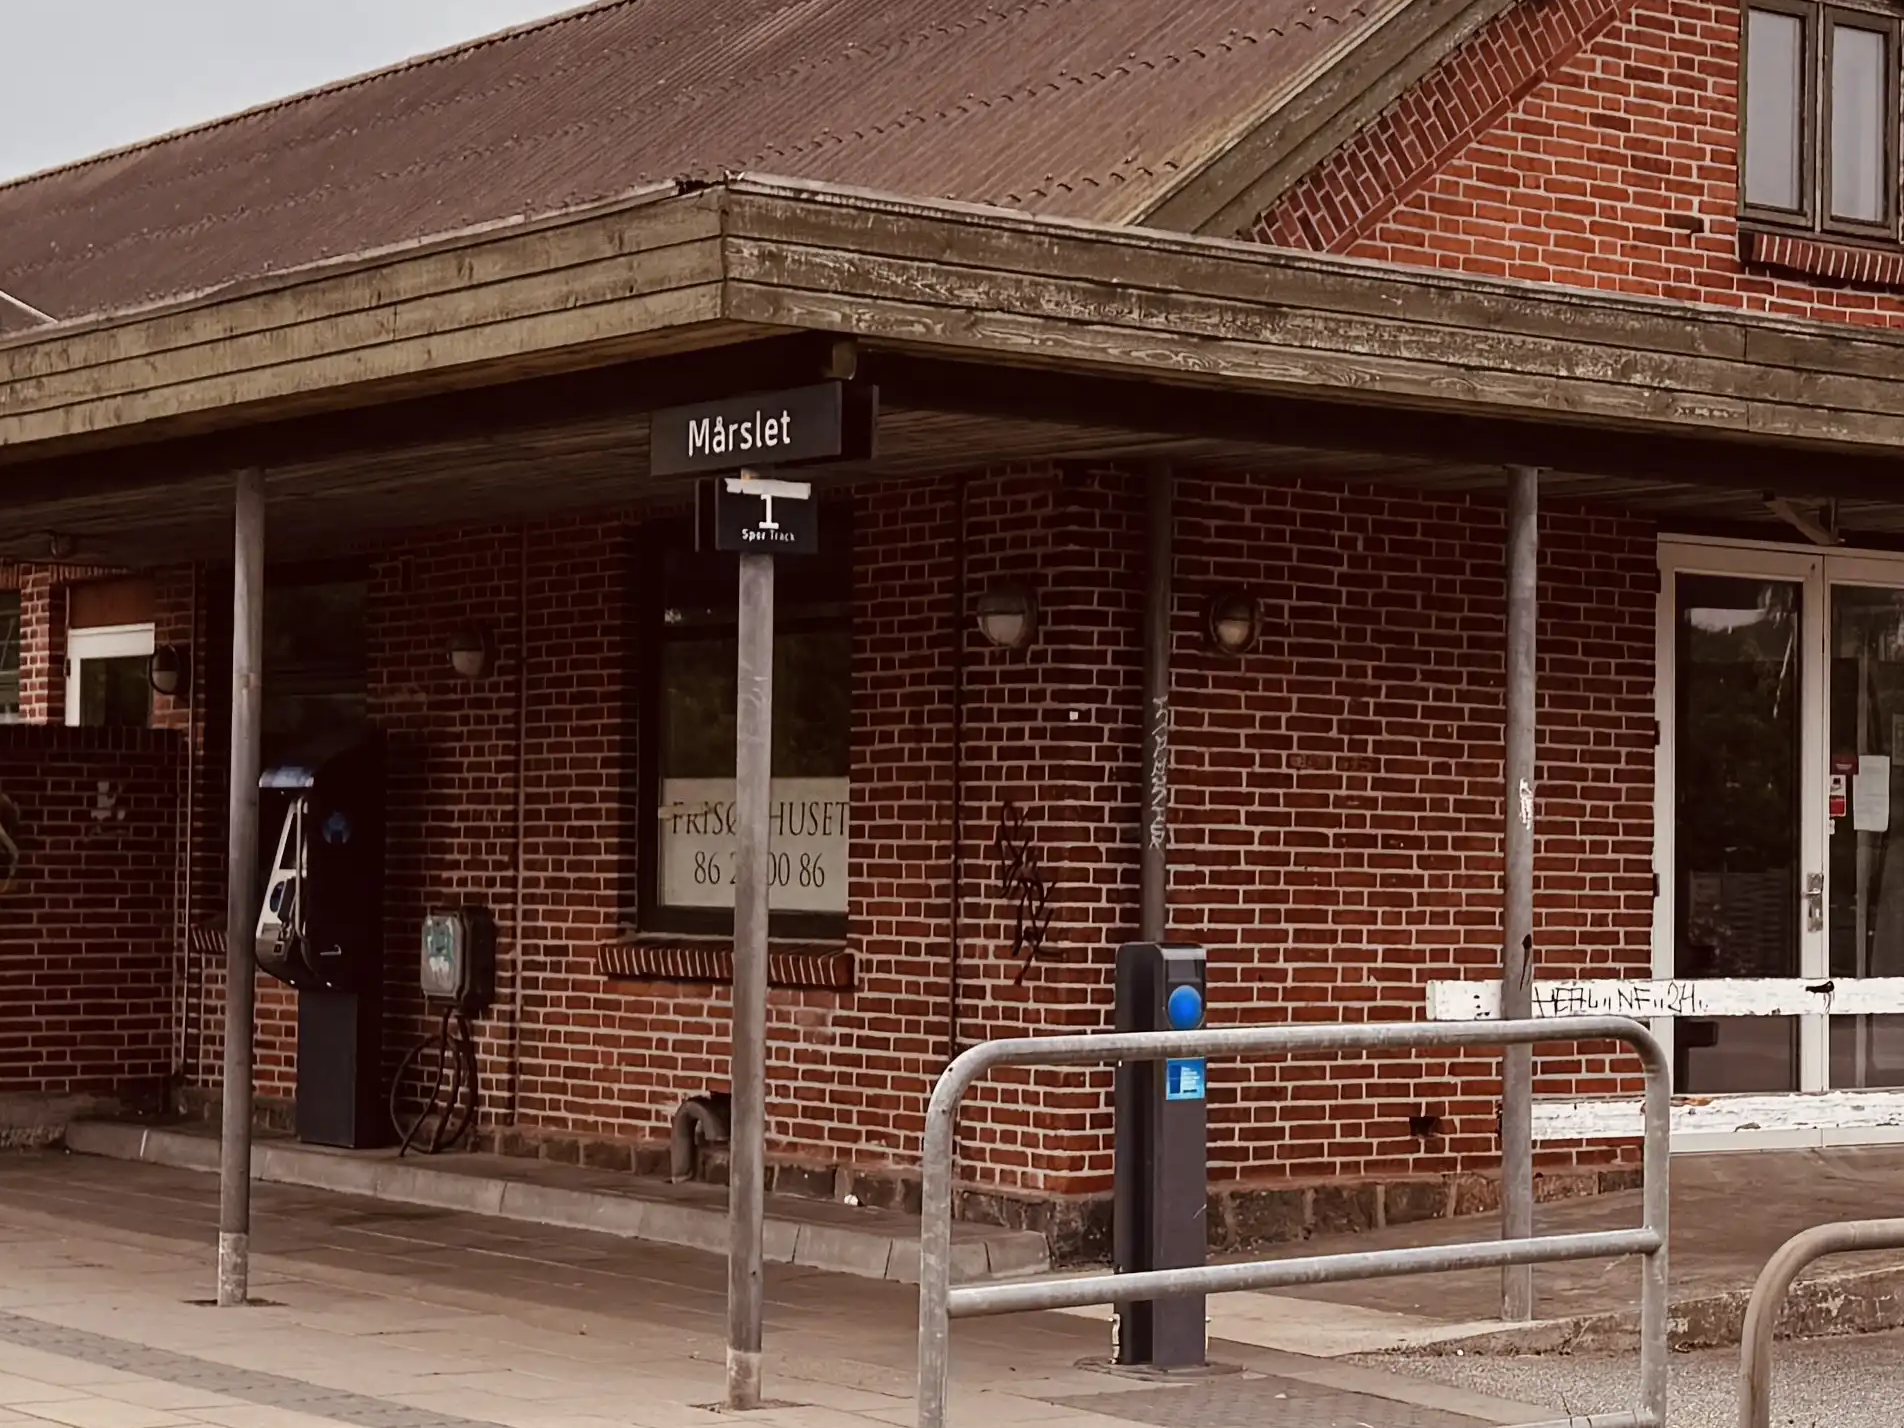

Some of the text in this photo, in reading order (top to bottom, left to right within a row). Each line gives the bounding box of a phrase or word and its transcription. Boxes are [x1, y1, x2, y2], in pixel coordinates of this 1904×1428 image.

[688, 409, 791, 458] Mårslet
[758, 493, 780, 530] 1
[693, 850, 721, 885] 86
[799, 852, 826, 888] 86
